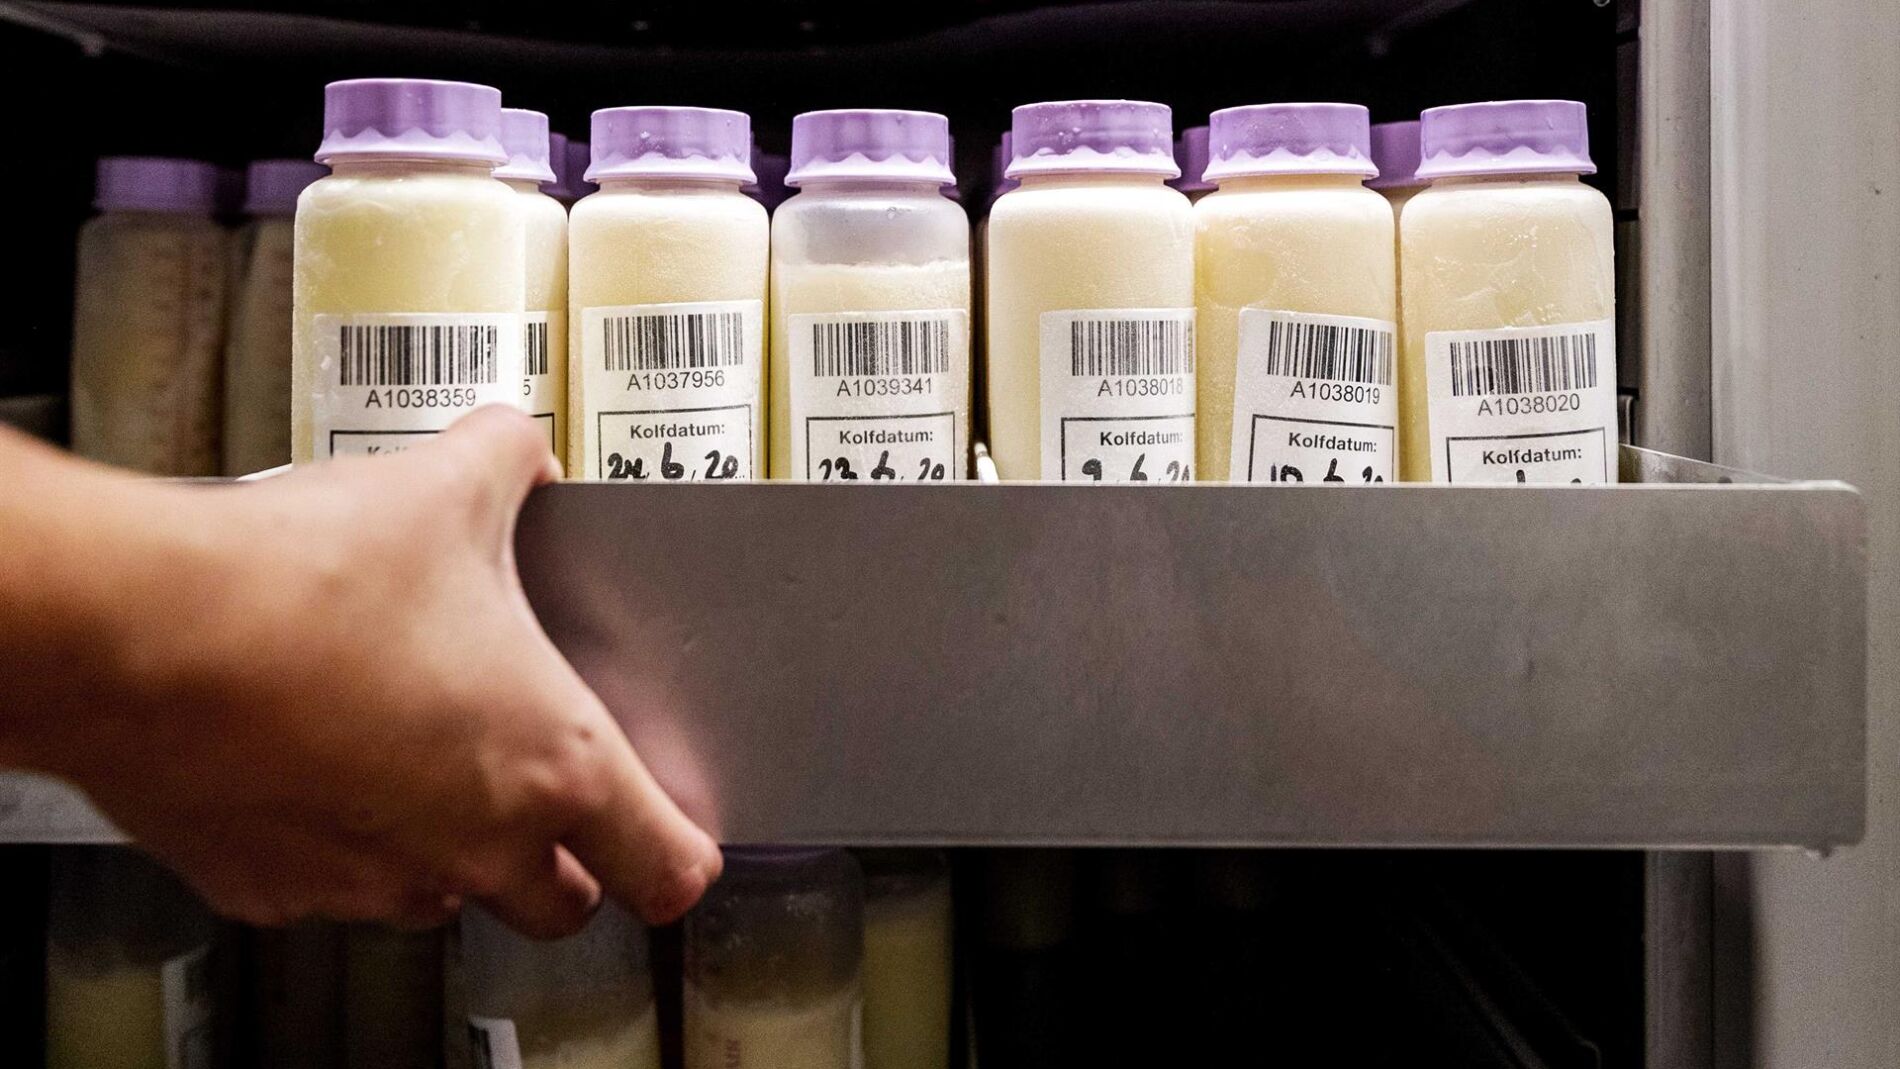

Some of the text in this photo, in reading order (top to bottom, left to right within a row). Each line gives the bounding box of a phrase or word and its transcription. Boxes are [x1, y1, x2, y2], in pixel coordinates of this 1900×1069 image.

[627, 370, 725, 391] A1037956
[836, 377, 933, 397] A1039341
[1097, 378, 1184, 397] A1038018
[365, 388, 476, 408] A1038359
[1290, 380, 1381, 404] A1038019
[1477, 392, 1581, 416] A1038020
[630, 423, 726, 440] Kolfdatum:
[839, 430, 934, 445] Kolfdatum:
[1100, 430, 1184, 447] Kolfdatum:
[1288, 432, 1377, 453] Kolfdatum:
[1482, 447, 1583, 466] Kolfdatum:
